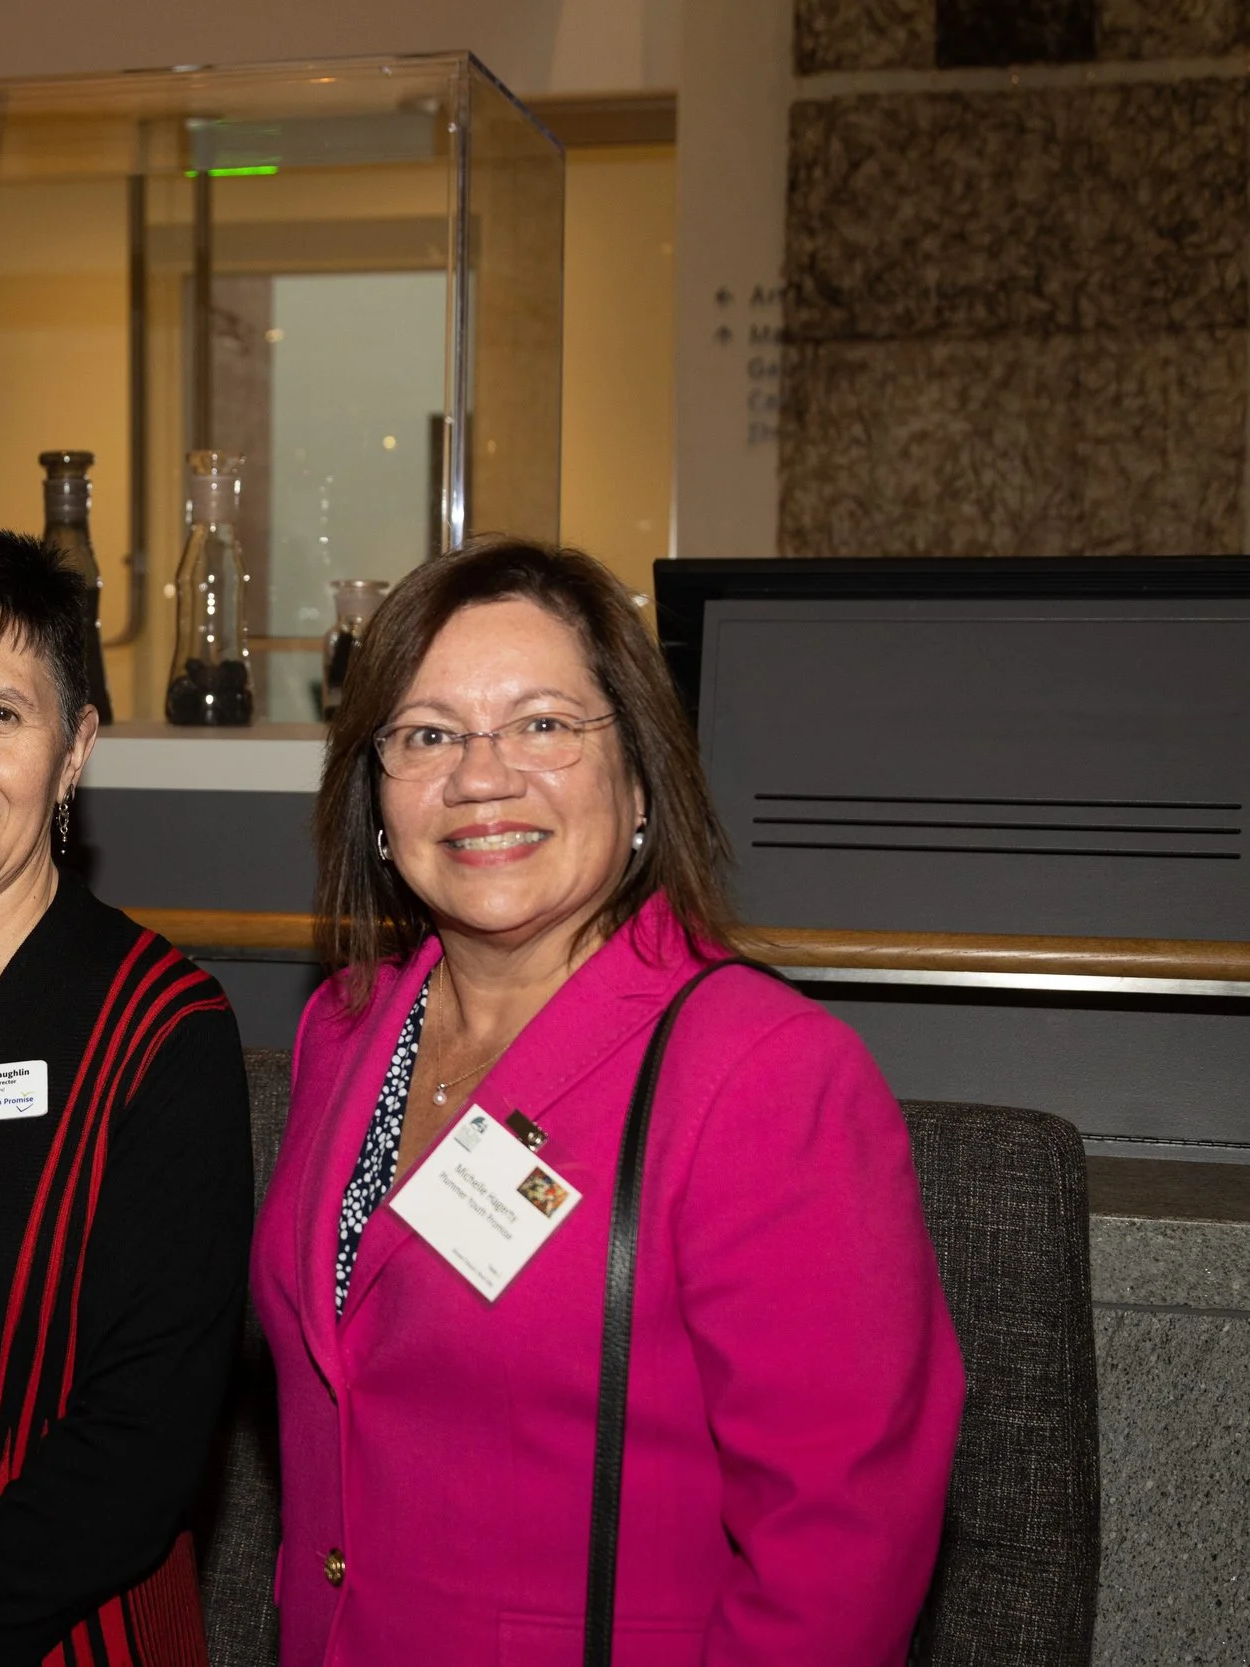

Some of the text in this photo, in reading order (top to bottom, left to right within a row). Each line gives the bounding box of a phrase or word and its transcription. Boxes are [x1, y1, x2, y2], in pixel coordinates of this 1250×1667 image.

[4, 1097, 34, 1105] Promise
[439, 1171, 467, 1200] Plummer
[454, 1163, 488, 1196] Michelle
